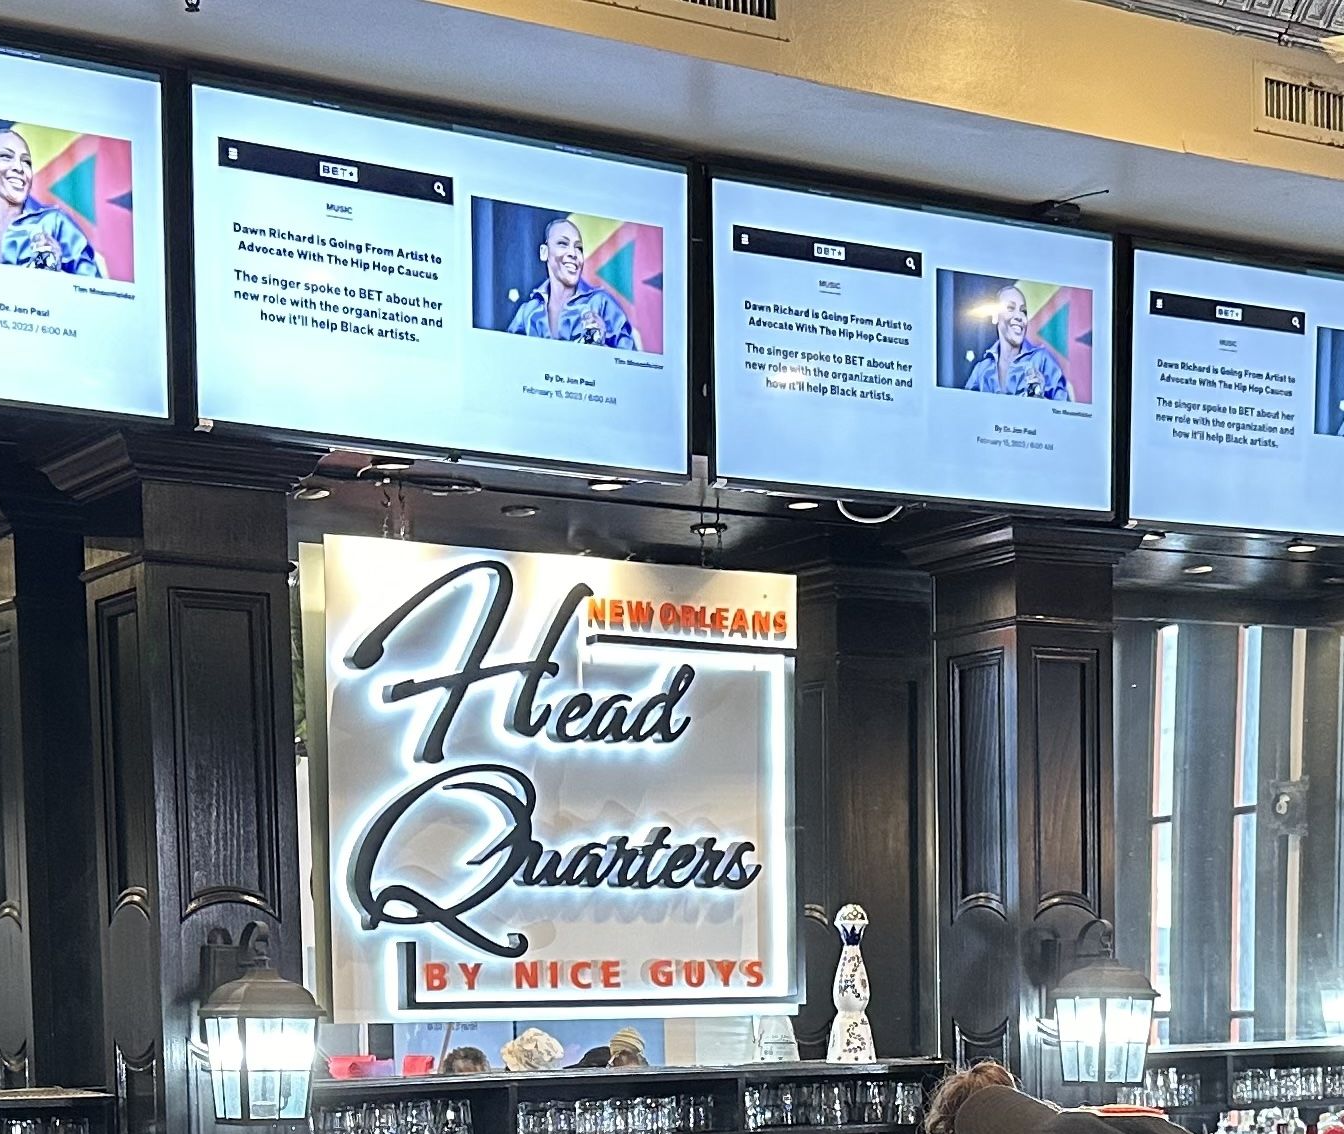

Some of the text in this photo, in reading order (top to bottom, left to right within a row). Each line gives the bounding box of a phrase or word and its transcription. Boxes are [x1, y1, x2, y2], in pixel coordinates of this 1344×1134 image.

[233, 222, 266, 236] Dawn
[268, 228, 314, 244] Richard
[329, 237, 362, 254] Going
[365, 242, 393, 257] From
[396, 248, 428, 262] Artist
[430, 254, 442, 264] to
[238, 240, 438, 280] Advocate With The Hip Hop Caucus
[234, 269, 442, 310] The singer spoke to BET about her
[234, 290, 442, 328] new role with the organization and
[260, 309, 286, 323] how
[311, 317, 337, 332] help
[340, 320, 374, 336] Black
[377, 328, 419, 342] artists.
[588, 599, 787, 635] NEW ORLEANS
[343, 560, 694, 764] Head
[346, 764, 762, 958] Quarters
[424, 960, 765, 991] BY NICE GUYS
